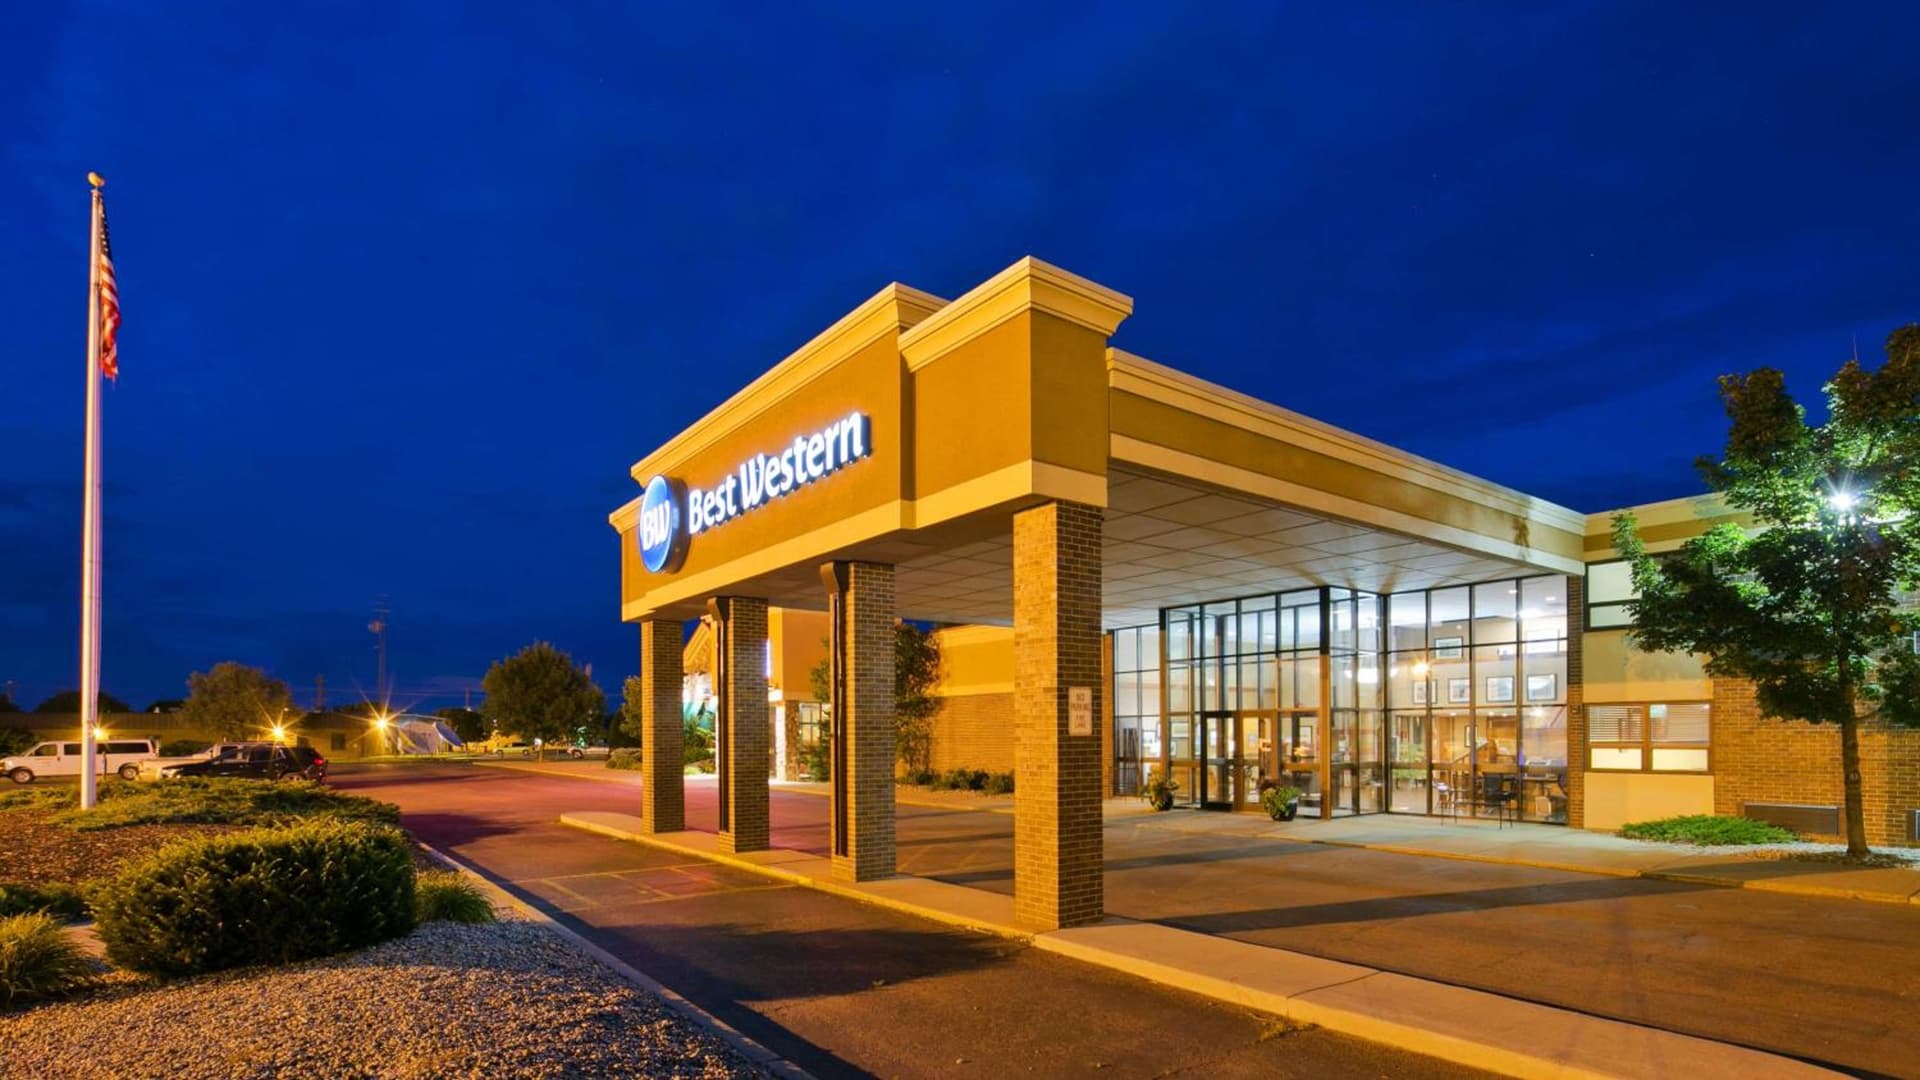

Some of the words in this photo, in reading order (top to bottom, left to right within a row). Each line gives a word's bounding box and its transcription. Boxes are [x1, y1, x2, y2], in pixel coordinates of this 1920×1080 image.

[688, 474, 737, 535] Best
[739, 411, 864, 511] Western
[642, 499, 671, 551] BW
